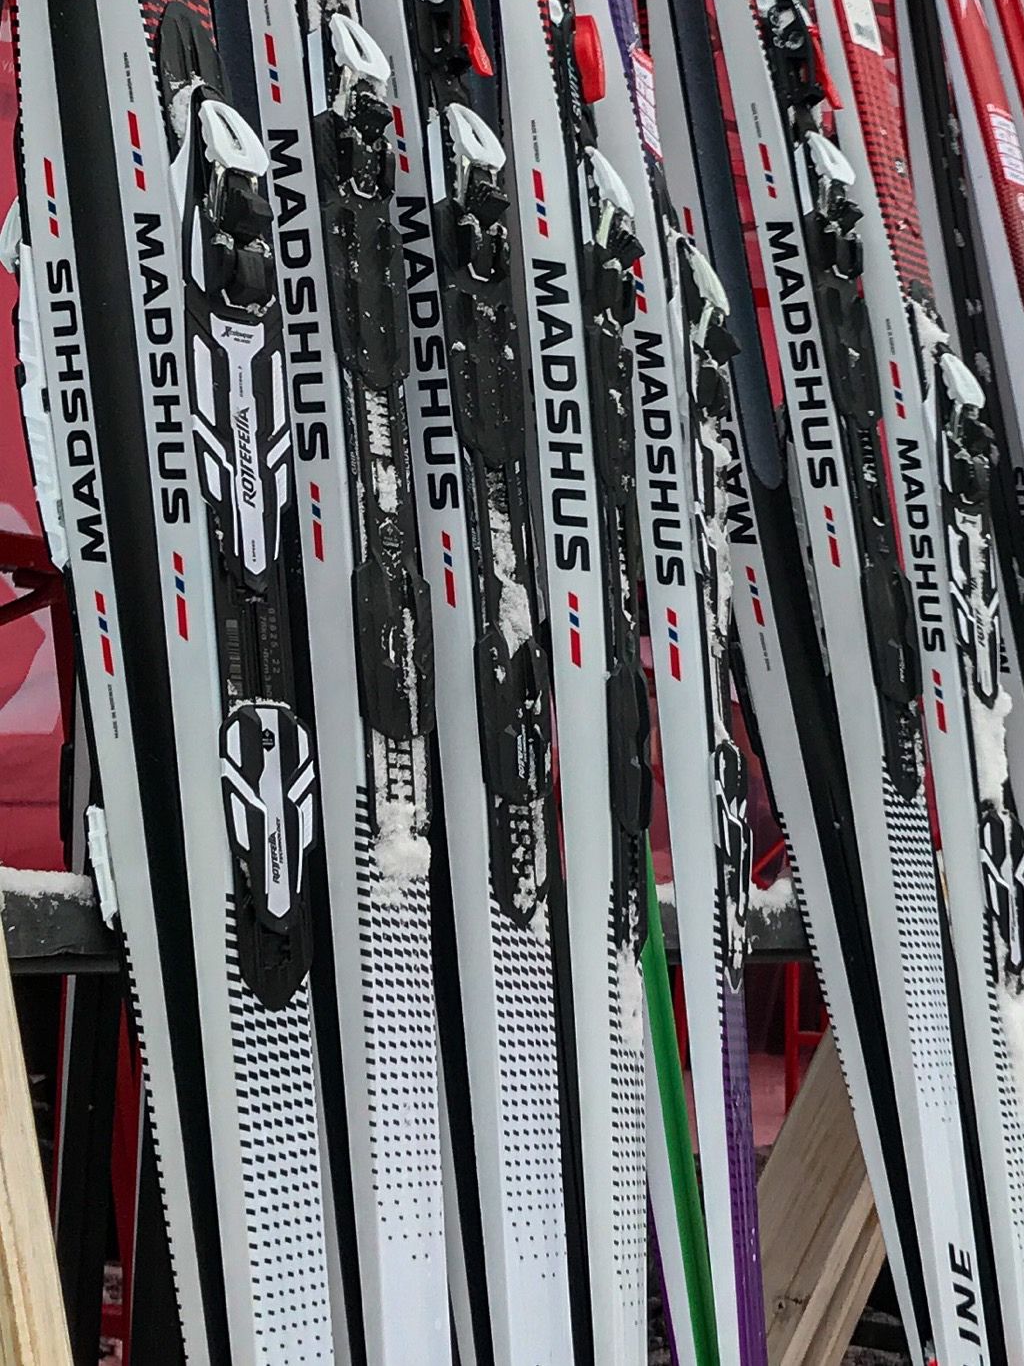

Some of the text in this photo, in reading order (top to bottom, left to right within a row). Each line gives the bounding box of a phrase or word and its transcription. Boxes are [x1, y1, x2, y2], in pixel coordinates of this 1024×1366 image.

[47, 258, 108, 563] MADSHUS
[133, 212, 190, 524] MADSHUS
[267, 129, 329, 461] MADSHUS
[395, 196, 459, 510] MADSHUS
[531, 257, 591, 572] MADSHUS
[766, 220, 839, 489] MADSHUS
[633, 330, 685, 587] MADSHUS
[897, 437, 946, 653] MADSHUS
